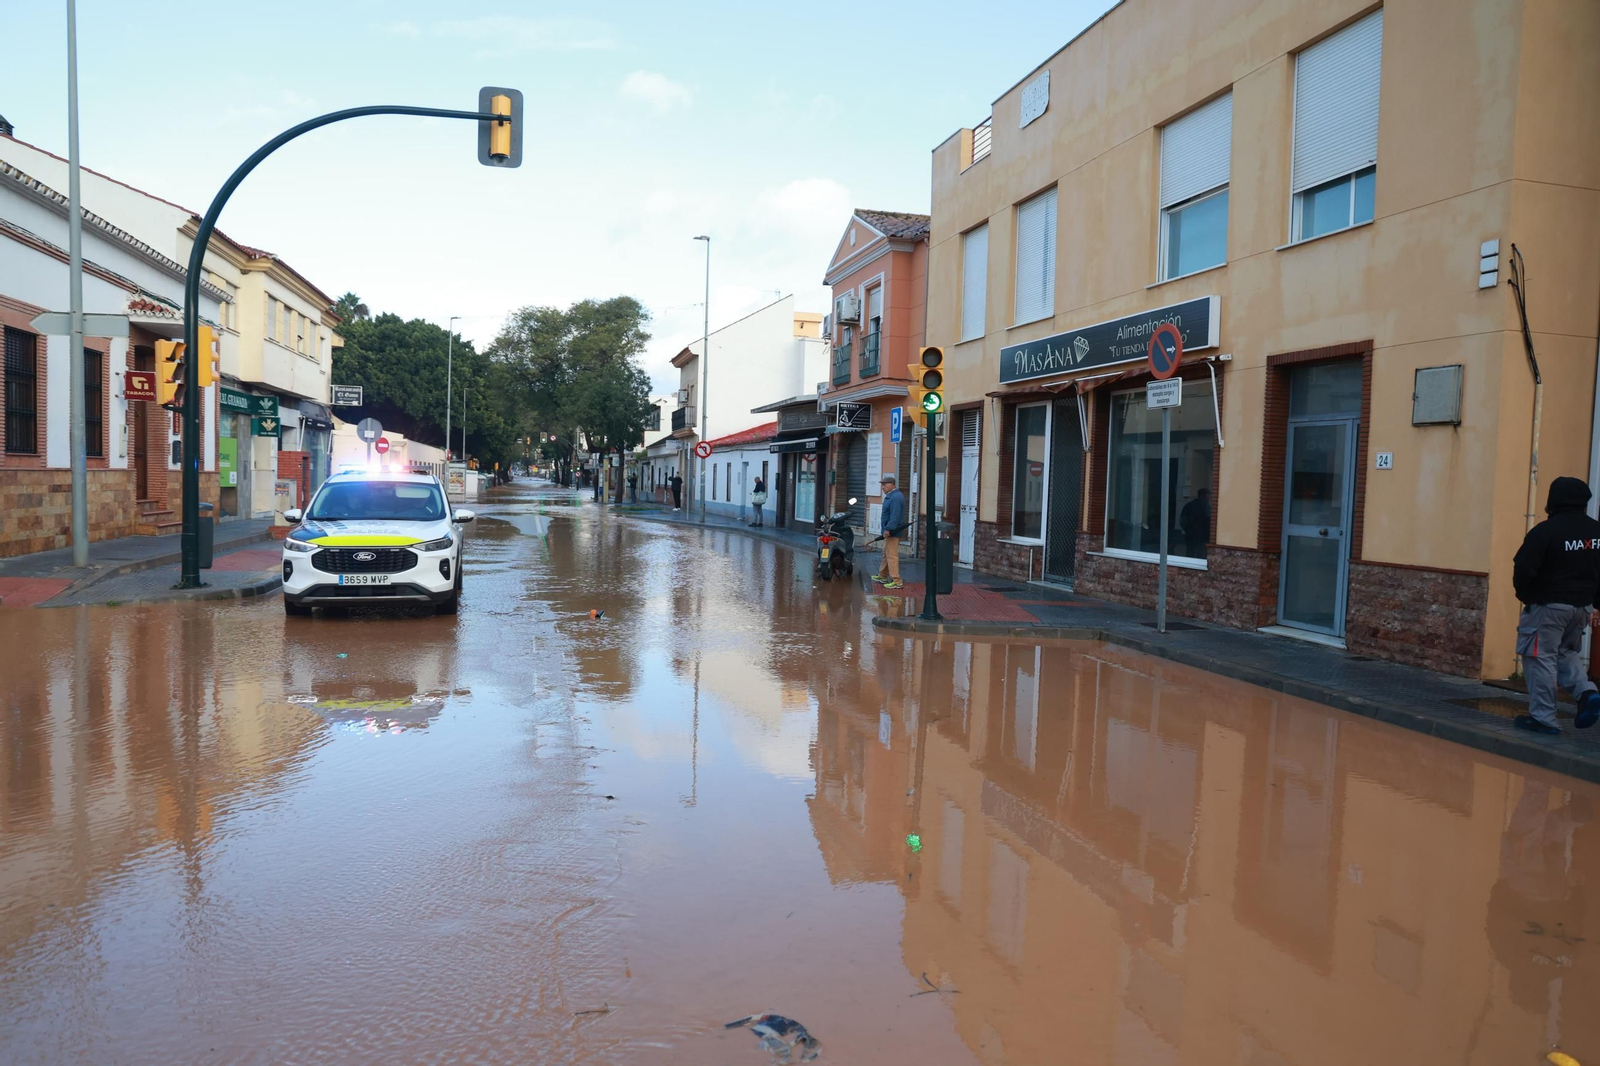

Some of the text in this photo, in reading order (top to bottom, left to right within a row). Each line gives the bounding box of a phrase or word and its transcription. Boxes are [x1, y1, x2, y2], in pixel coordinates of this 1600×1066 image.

[228, 394, 248, 408] GRANADA
[892, 412, 899, 438] P
[1379, 455, 1388, 466] 24
[344, 575, 388, 584] 3659 MVP
